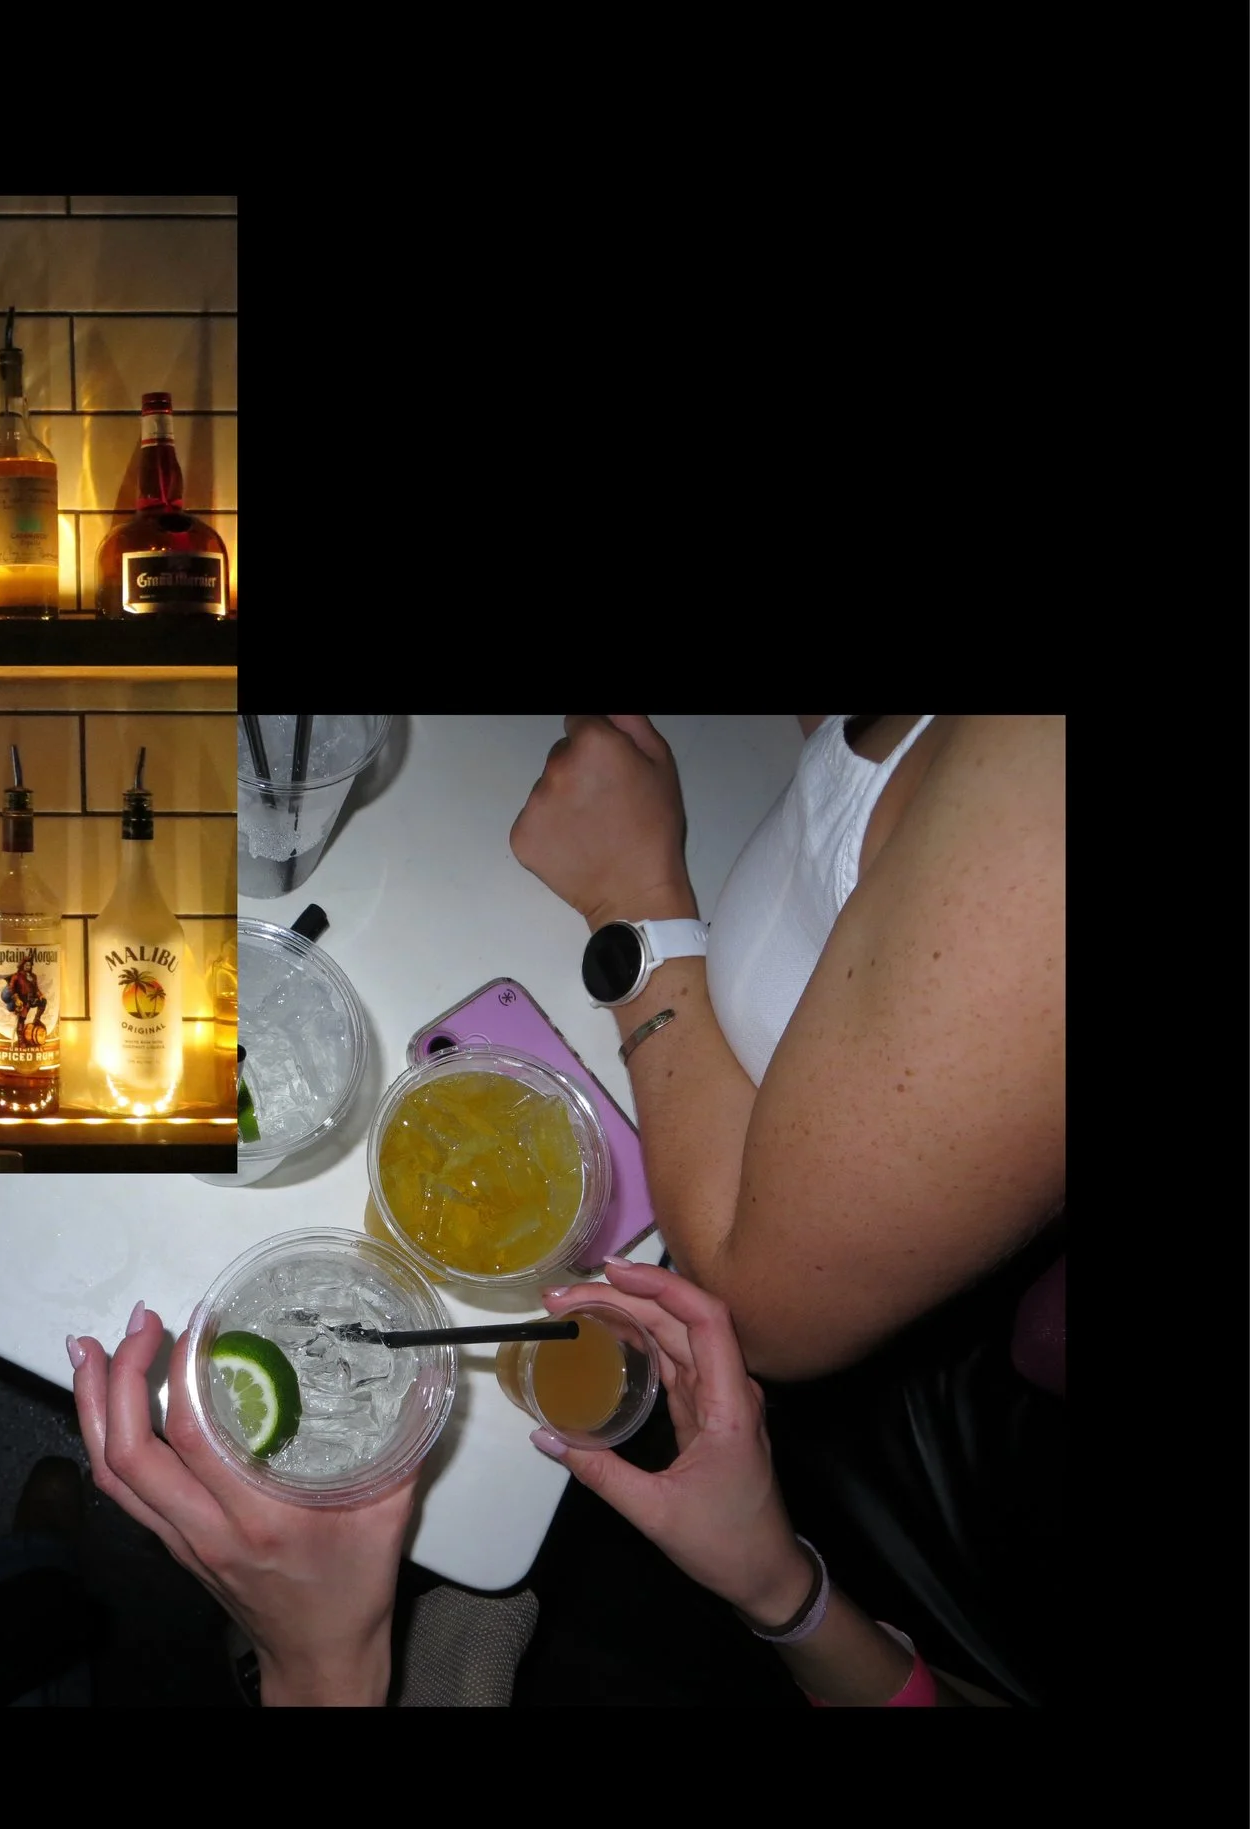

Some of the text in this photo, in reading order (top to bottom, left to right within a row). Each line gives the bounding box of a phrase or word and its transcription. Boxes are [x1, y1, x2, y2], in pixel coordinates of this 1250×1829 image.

[136, 572, 173, 588] Grand
[25, 947, 58, 966] Morgan
[104, 945, 179, 974] MALIBU
[121, 1021, 167, 1035] ORIGINAL
[35, 1052, 54, 1062] RUM
